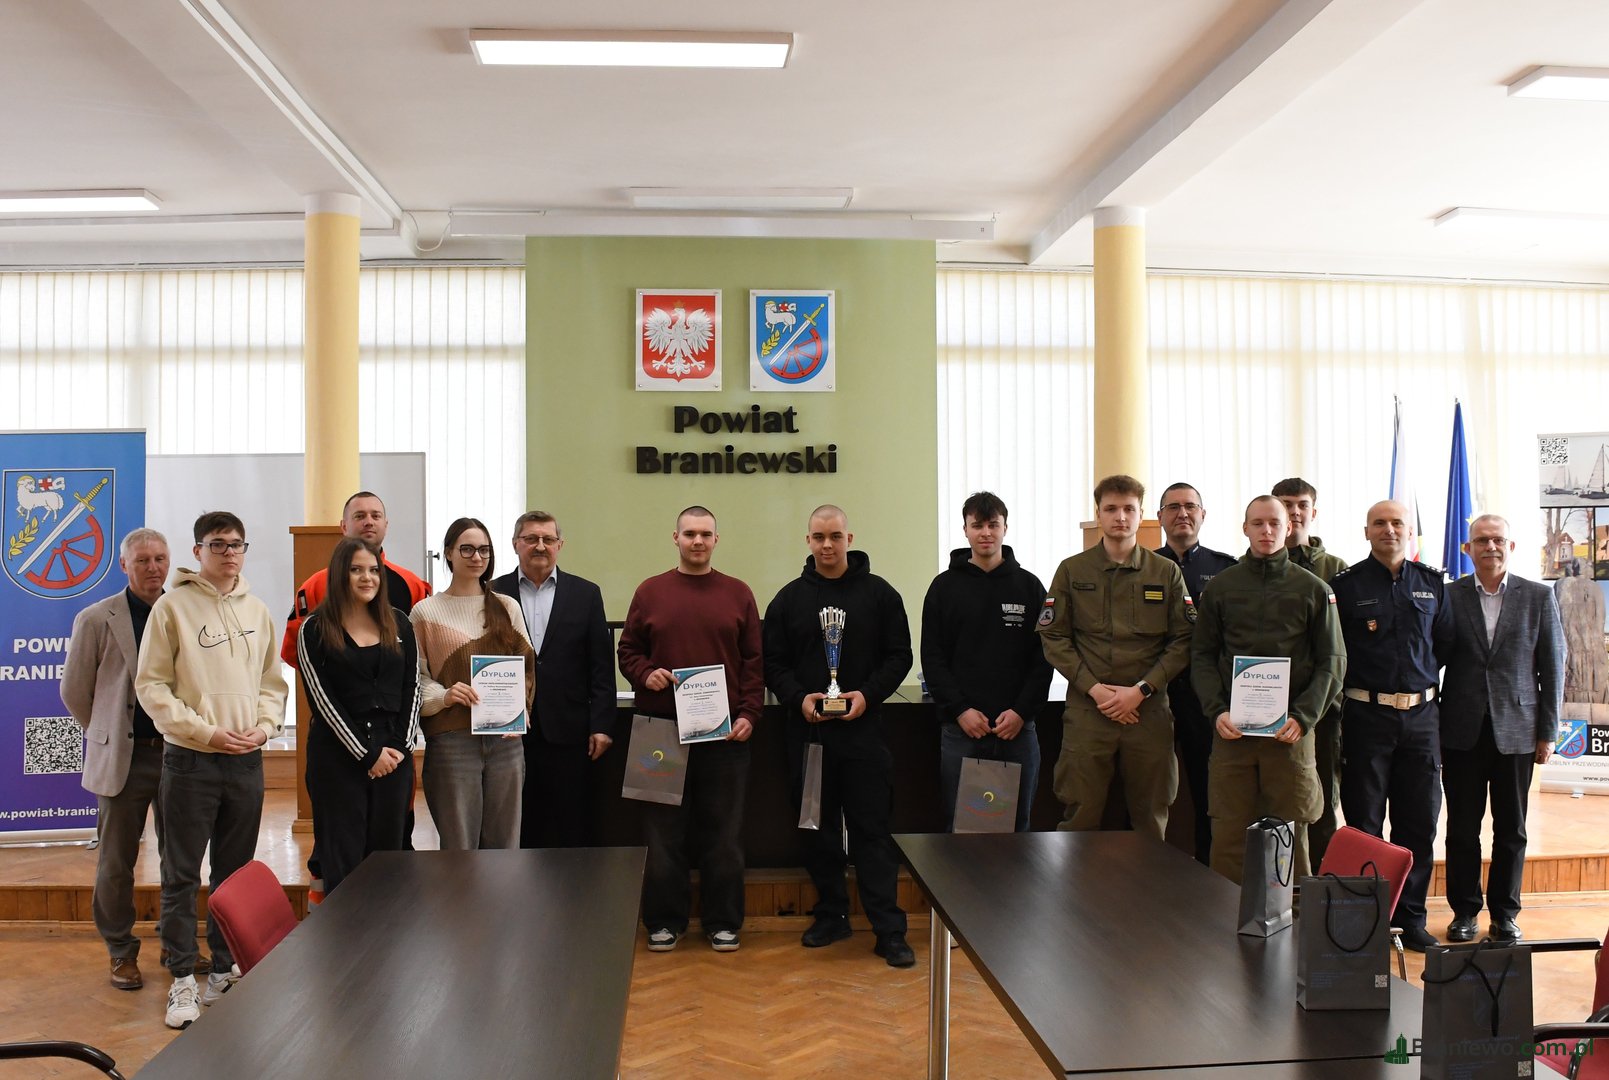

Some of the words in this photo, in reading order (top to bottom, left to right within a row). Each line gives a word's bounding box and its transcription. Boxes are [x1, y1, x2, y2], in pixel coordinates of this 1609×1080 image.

[674, 404, 799, 434] Powiat
[636, 444, 837, 474] Braniewski
[1412, 591, 1435, 599] POLICJA
[481, 670, 516, 678] DYPLOM
[1243, 671, 1280, 680] DYPLOM
[683, 681, 717, 690] DYPLOM
[0, 806, 99, 821] w.powiat-branie
